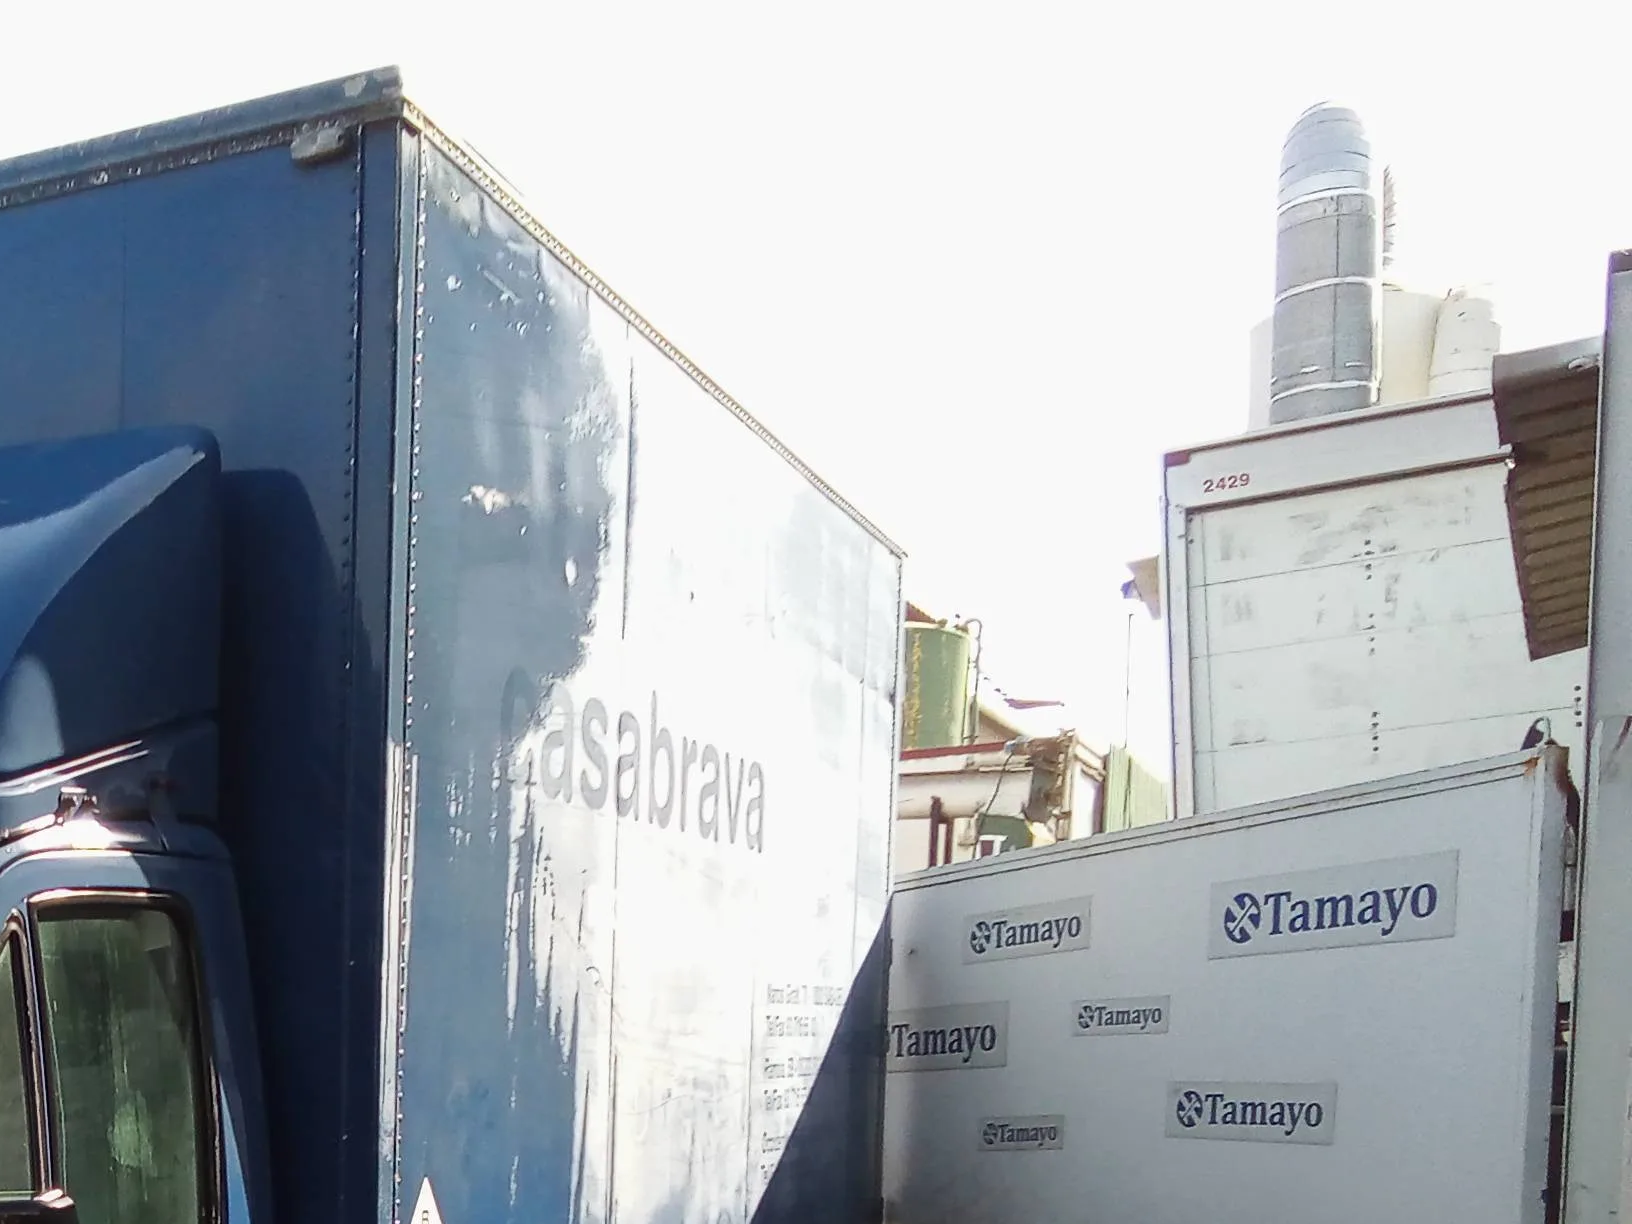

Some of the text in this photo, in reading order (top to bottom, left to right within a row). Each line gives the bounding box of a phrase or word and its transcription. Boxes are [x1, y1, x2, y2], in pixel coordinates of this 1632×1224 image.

[1202, 472, 1251, 493] 2429
[1263, 882, 1439, 937] Tamayo
[991, 915, 1082, 948] Tamayo
[1095, 1006, 1163, 1031] Tamayo
[891, 1023, 997, 1063] Tamayo
[1204, 1093, 1324, 1137] Tamayo
[997, 1122, 1058, 1147] Tamayo
